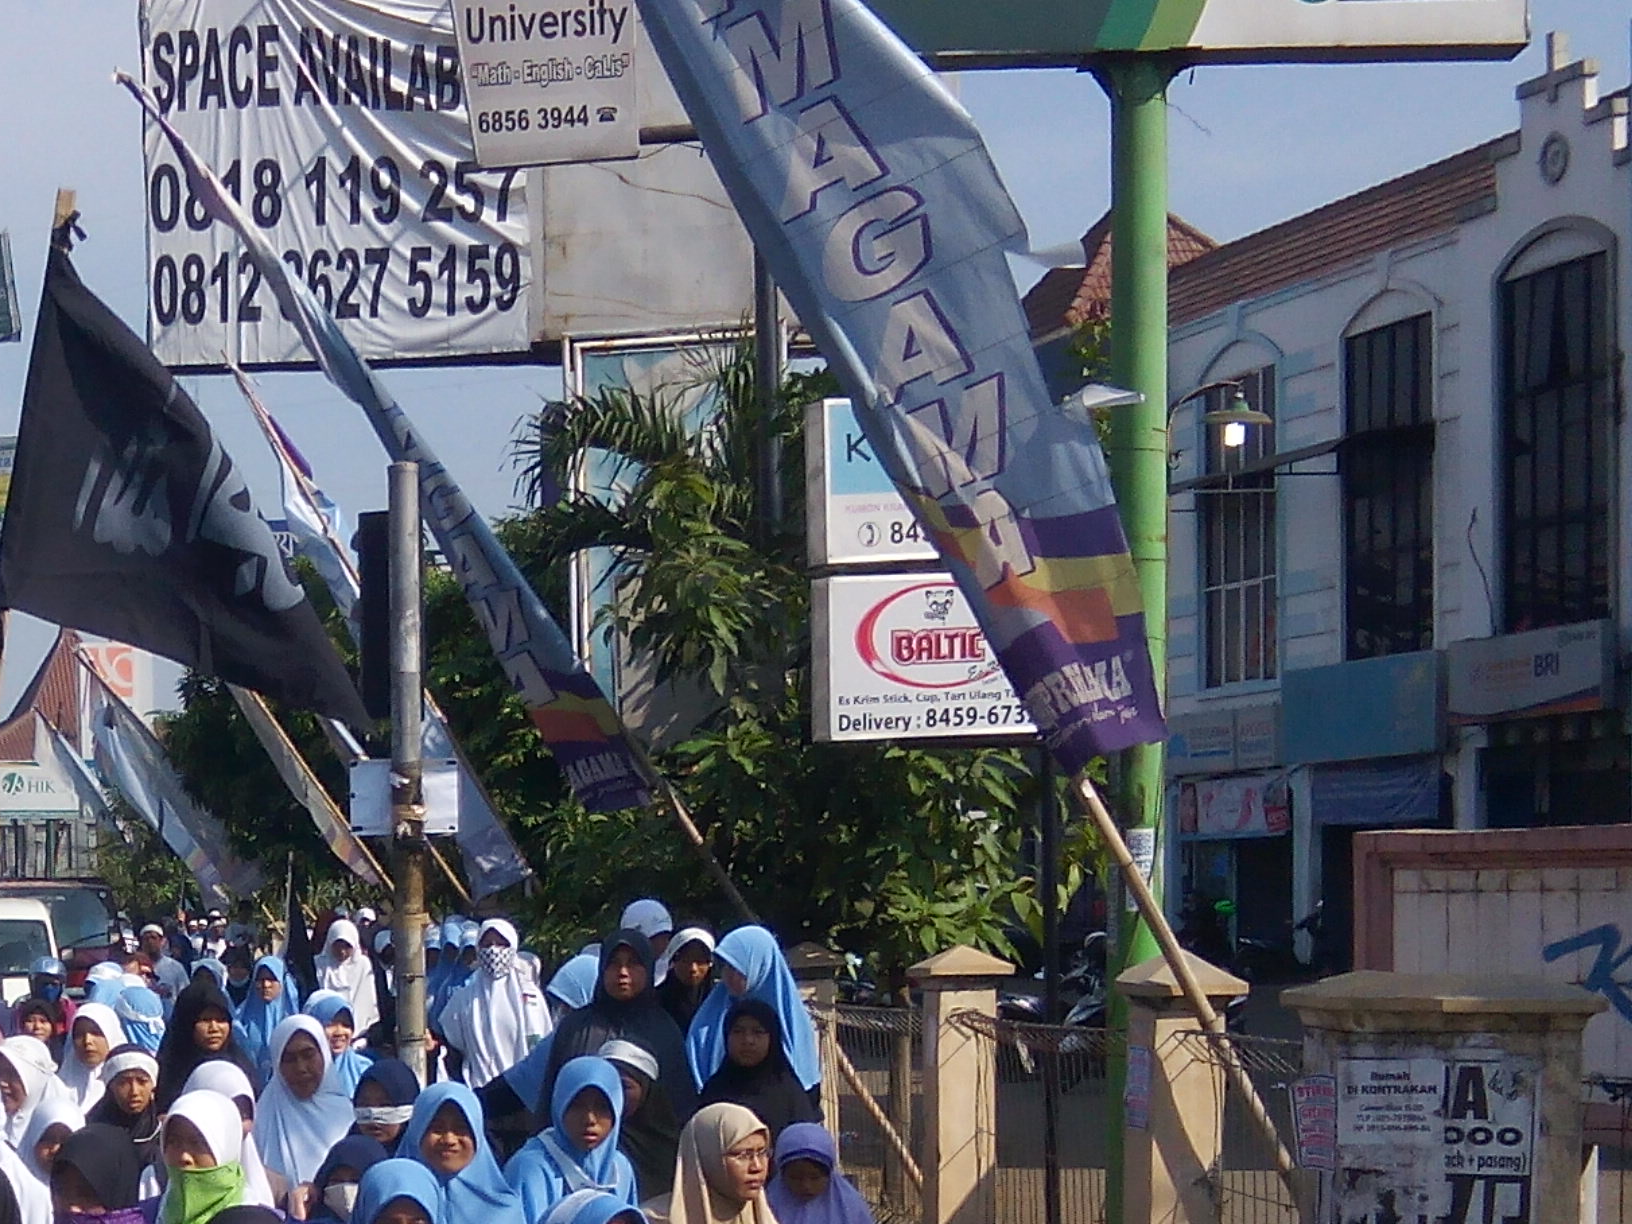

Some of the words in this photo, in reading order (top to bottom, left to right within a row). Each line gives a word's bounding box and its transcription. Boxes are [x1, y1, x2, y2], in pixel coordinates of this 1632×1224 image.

[466, 0, 628, 44] University
[153, 25, 281, 113] SPACE
[294, 27, 461, 112] AVAILAB
[523, 58, 573, 88] English
[478, 111, 529, 133] 6856
[538, 105, 589, 129] 3944
[305, 155, 401, 226] 119
[421, 160, 518, 224] 257
[153, 252, 262, 327] 0812
[408, 243, 520, 318] 5159
[890, 520, 930, 544] 84
[1534, 652, 1560, 678] BRI
[839, 695, 850, 705] Es
[853, 694, 880, 706] Krim
[944, 691, 967, 702] Tart
[970, 690, 1002, 703] Ulang
[839, 712, 912, 734] Delivery
[925, 704, 1034, 728] 8459-673
[27, 780, 57, 794] HIK
[1361, 1084, 1437, 1095] KONTRAKAN
[1476, 1152, 1528, 1172] pasang)
